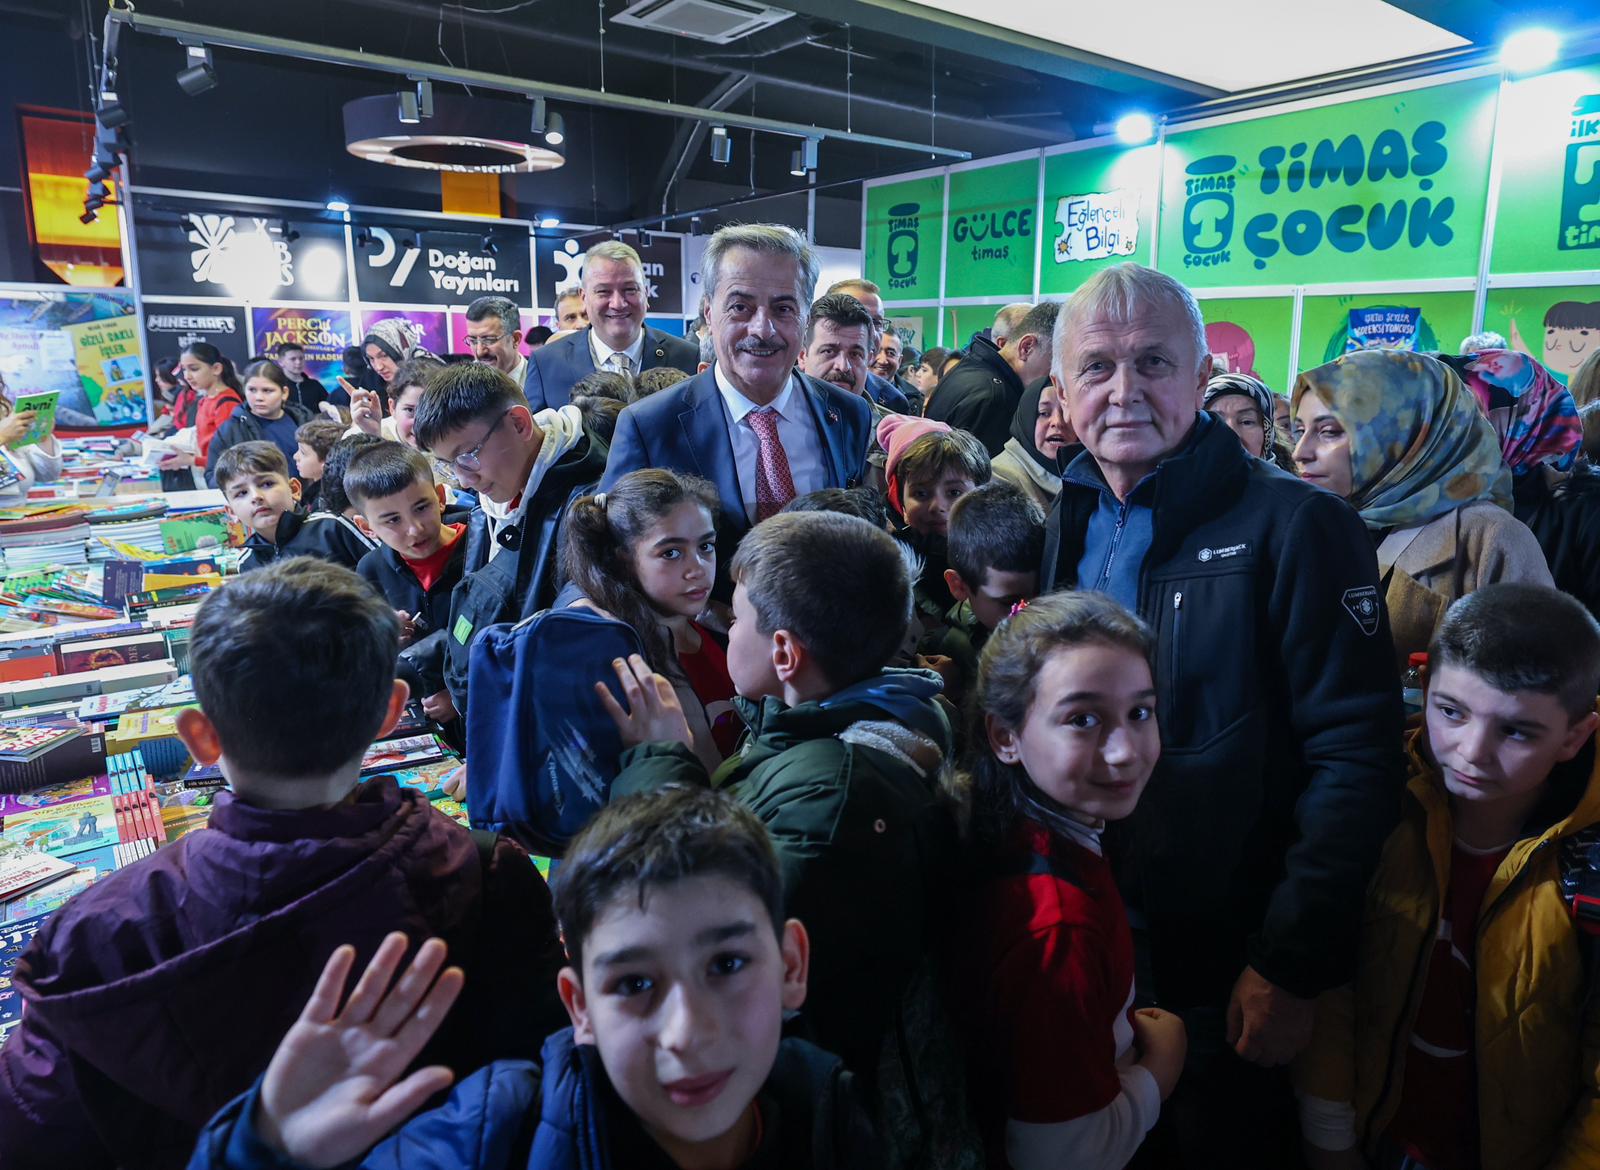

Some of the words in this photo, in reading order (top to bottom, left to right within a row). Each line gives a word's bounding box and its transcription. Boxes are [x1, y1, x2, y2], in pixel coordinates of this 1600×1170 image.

[953, 209, 1032, 242] GÜLCE
[1244, 197, 1454, 270] ÇOCUK
[1085, 226, 1120, 253] Bilgi
[428, 249, 496, 274] Doğan
[971, 245, 1009, 261] timaş
[1183, 251, 1230, 268] ÇOCUK
[429, 270, 519, 295] Yayınları
[147, 315, 236, 333] MINECRAFT
[277, 317, 331, 331] PERCY
[264, 330, 346, 351] JACKSON
